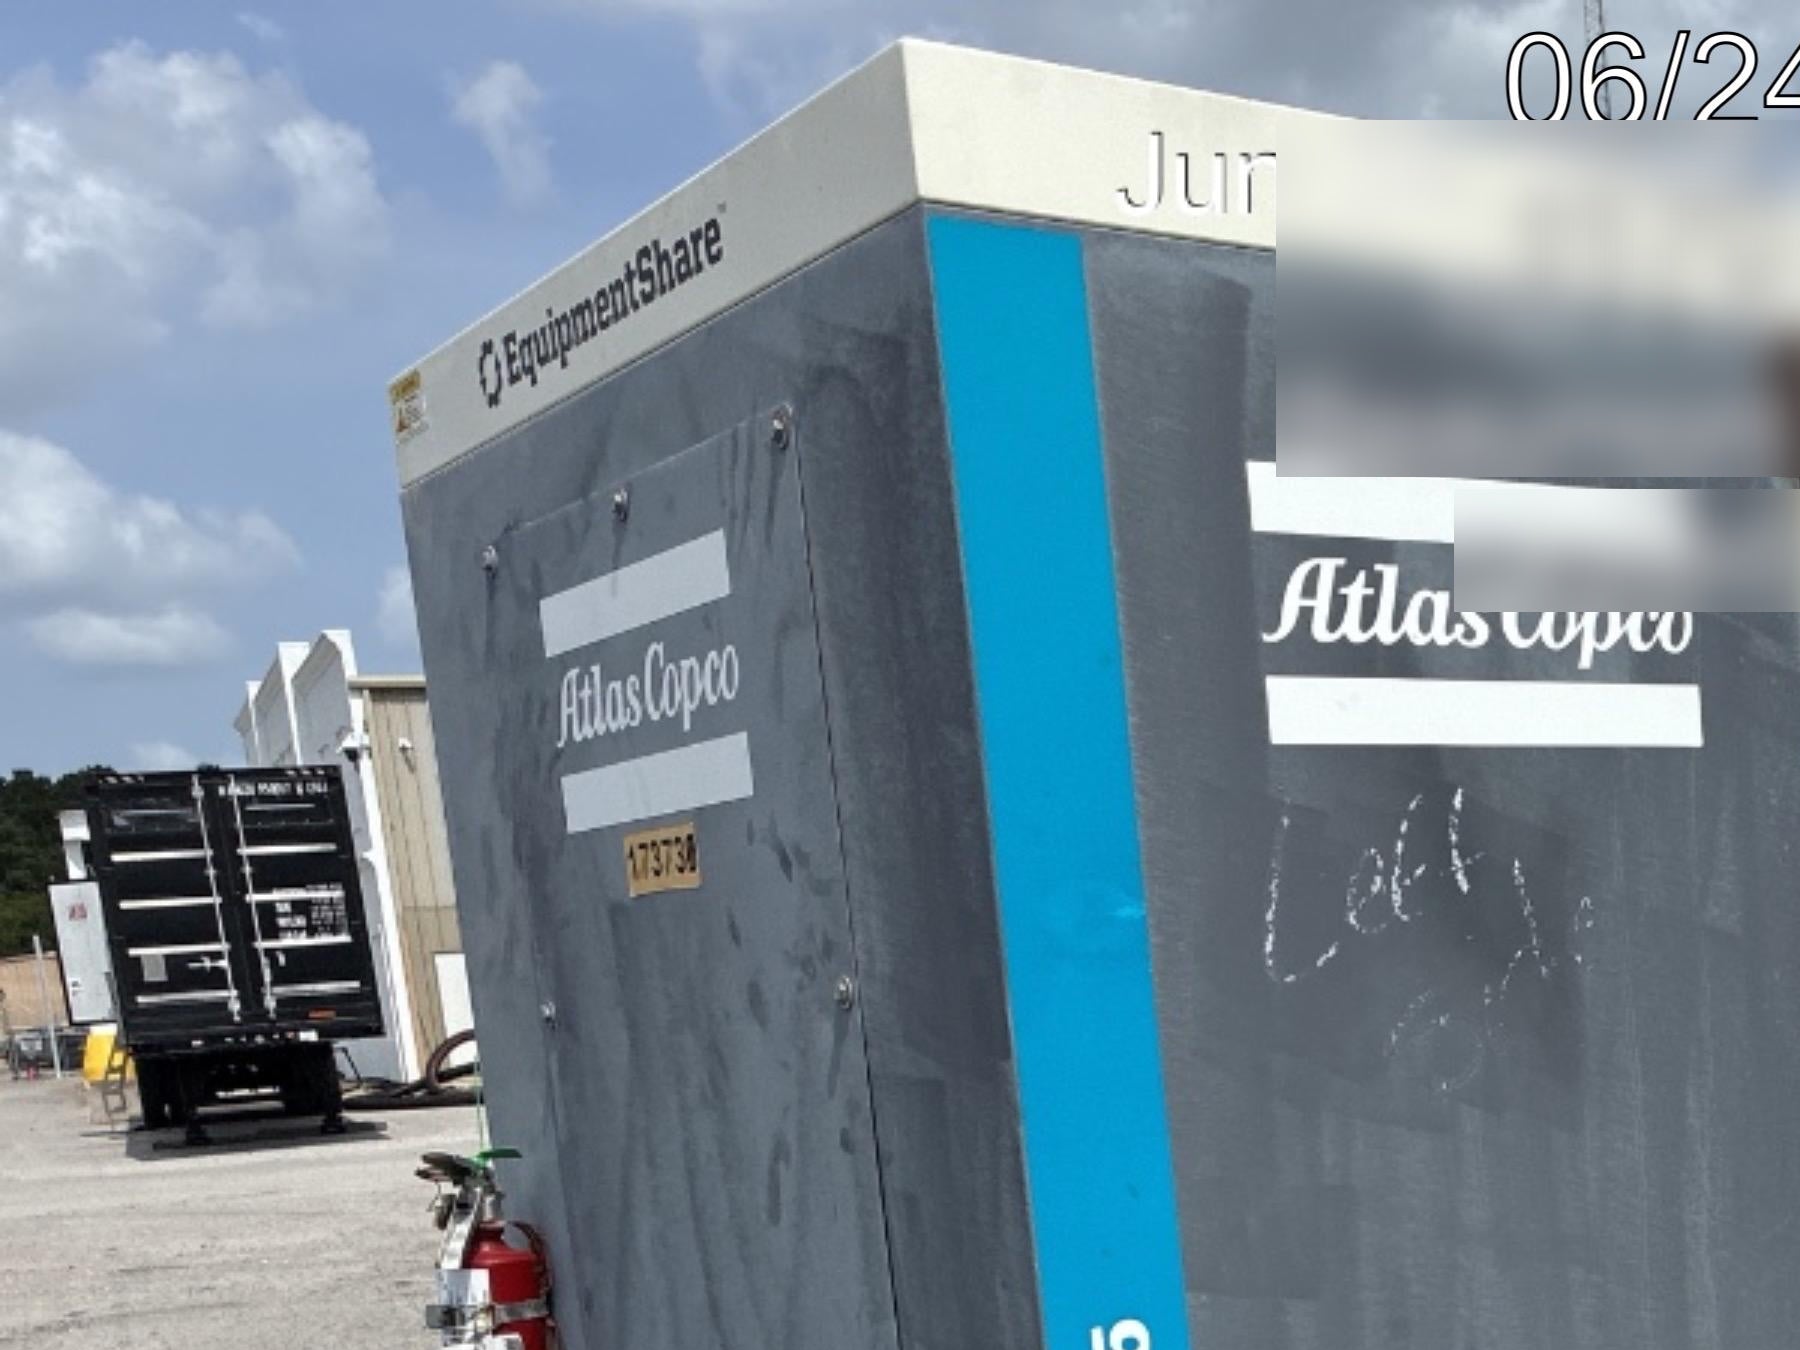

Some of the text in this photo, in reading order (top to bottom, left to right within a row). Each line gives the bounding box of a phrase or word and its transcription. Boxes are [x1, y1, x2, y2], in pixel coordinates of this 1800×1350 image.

[502, 217, 724, 388] EquipmentShare
[1262, 556, 1490, 648] Atlas
[557, 641, 740, 748] Atlas Copco
